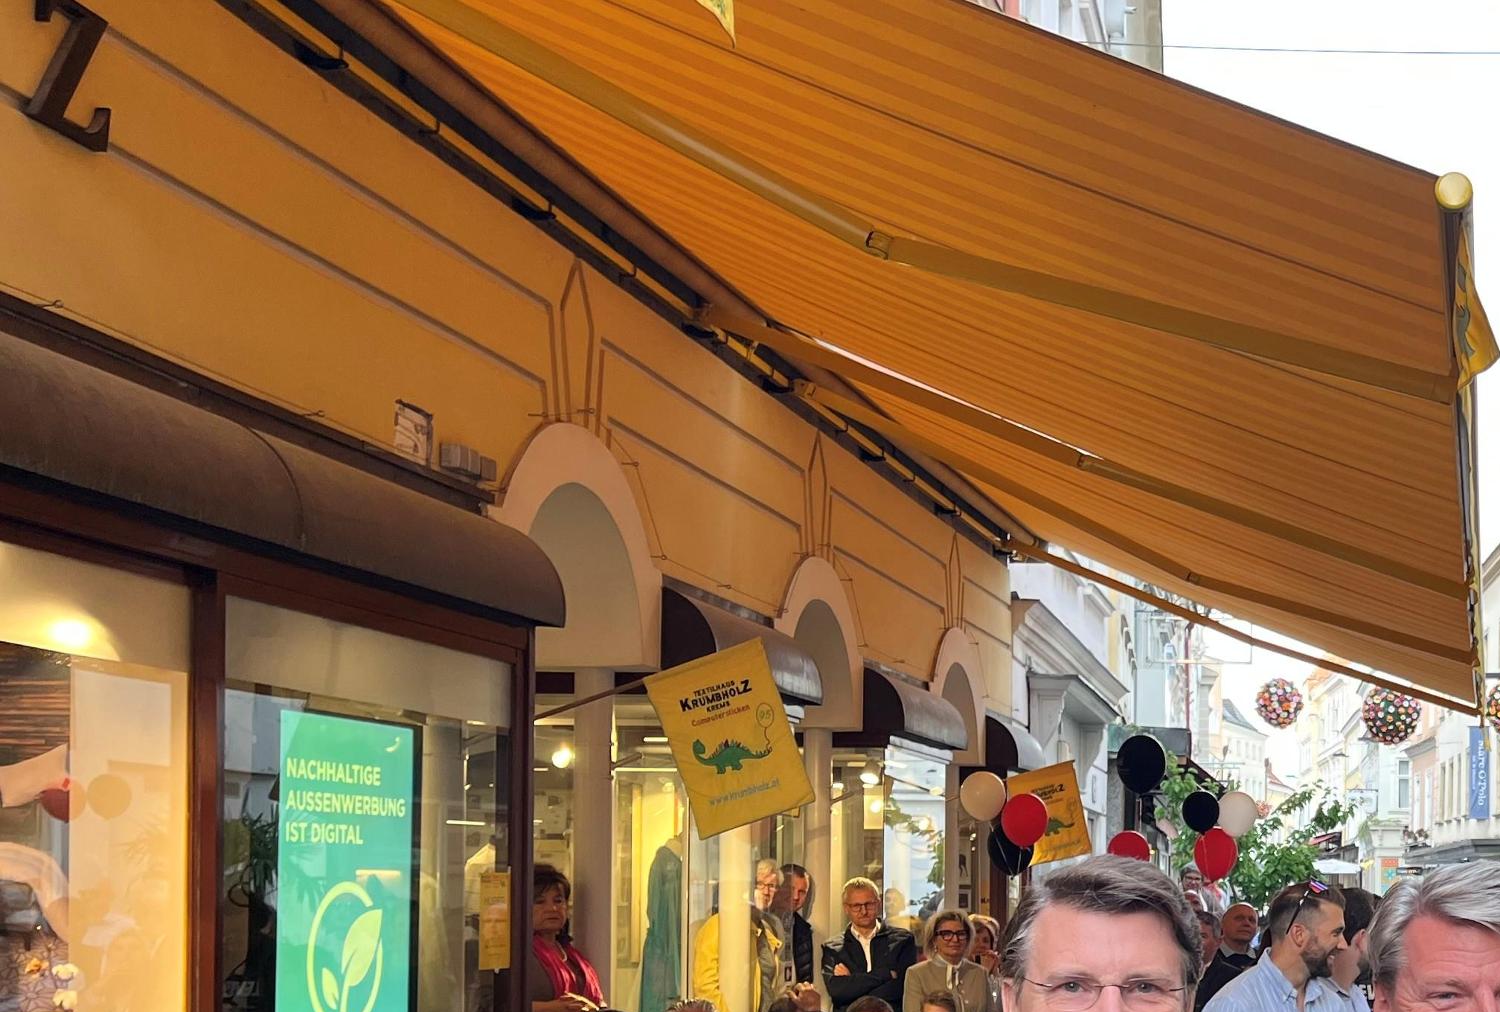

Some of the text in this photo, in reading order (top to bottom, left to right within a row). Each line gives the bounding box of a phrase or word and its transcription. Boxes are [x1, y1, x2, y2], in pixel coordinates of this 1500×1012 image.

[680, 679, 752, 712] KRUMBHOLZ
[706, 701, 731, 713] KREMS
[286, 757, 381, 786] NACHHALTIGE
[285, 790, 406, 817] AUSSENWERBUNG
[285, 821, 364, 845] IST DIGITAL
